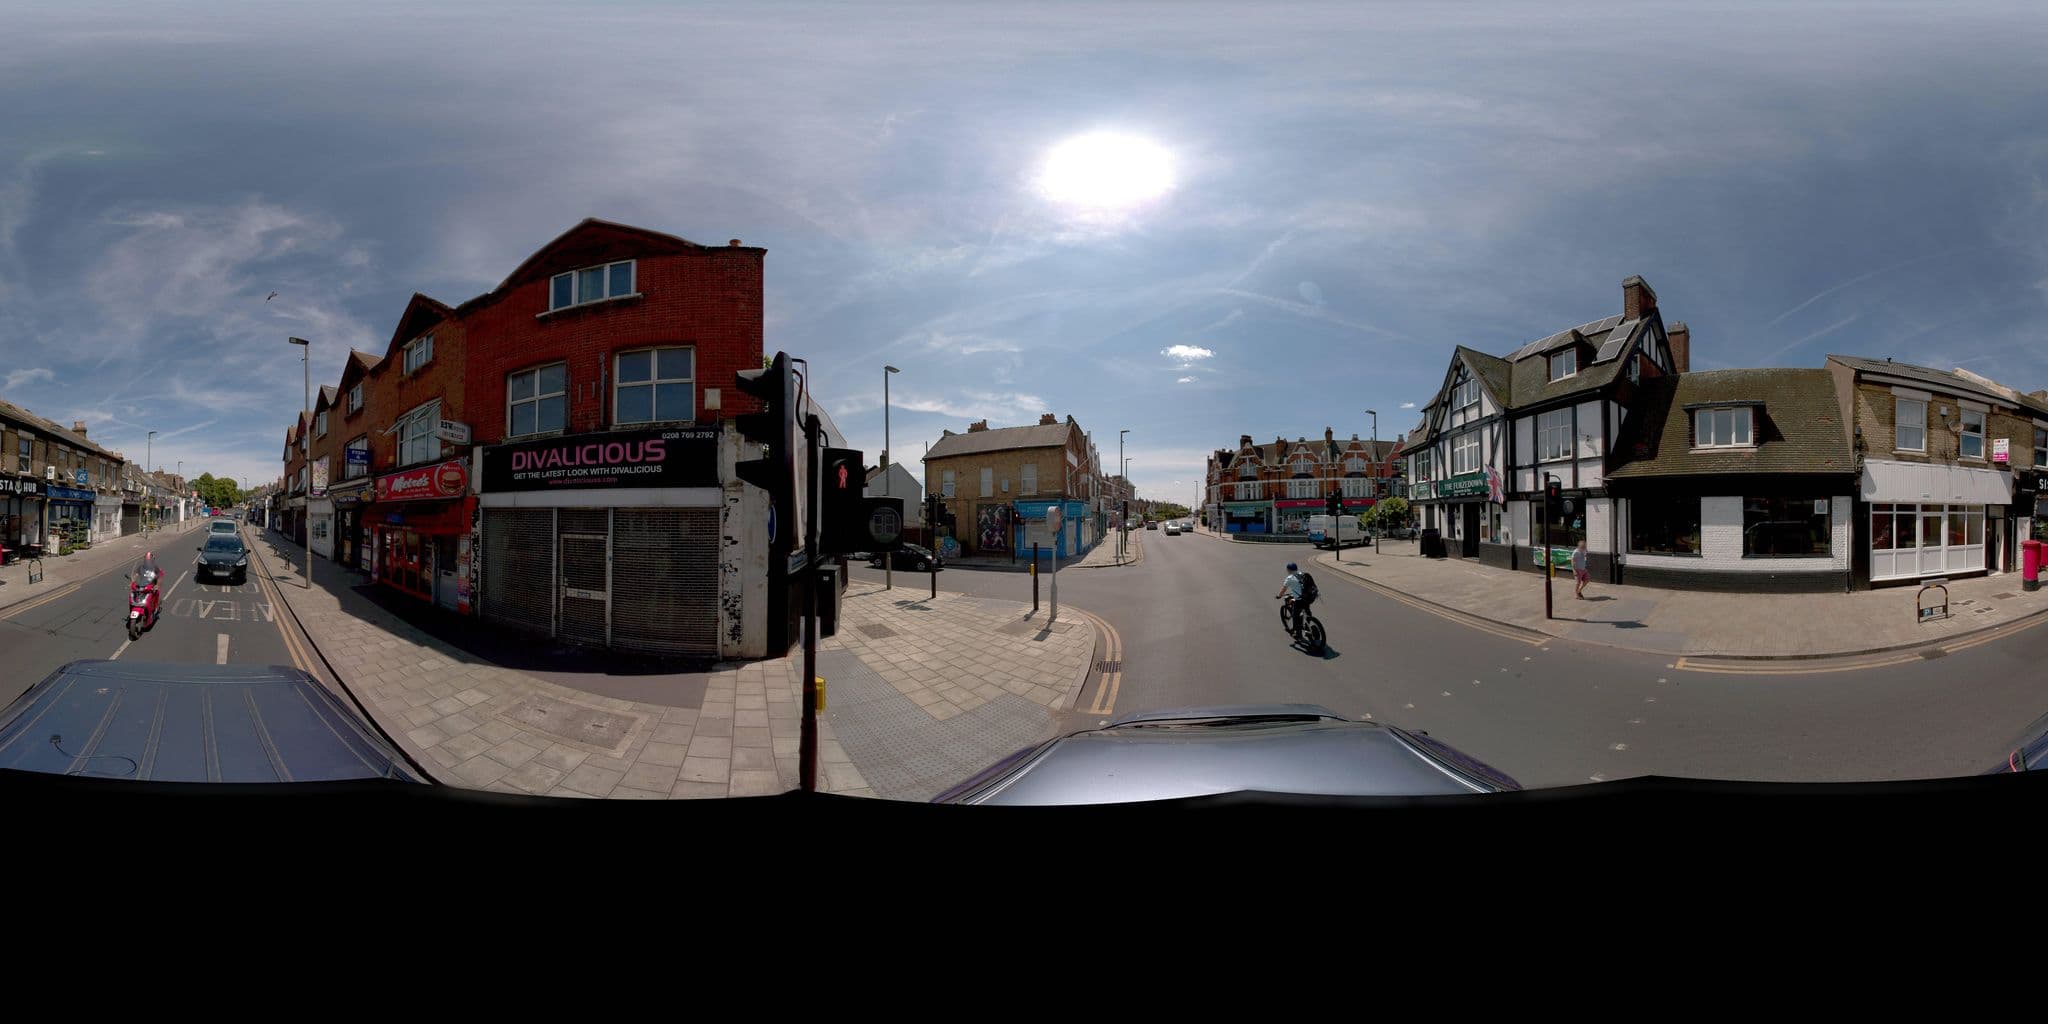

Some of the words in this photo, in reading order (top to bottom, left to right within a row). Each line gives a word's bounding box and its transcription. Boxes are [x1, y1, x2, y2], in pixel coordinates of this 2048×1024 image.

[662, 432, 679, 440] 0208
[696, 431, 714, 439] 2792
[511, 439, 666, 471] DIVALICIOUS
[514, 472, 526, 480] GET
[528, 471, 540, 479] THE
[541, 469, 566, 478] LATEST
[567, 468, 588, 476] LOOK
[589, 467, 610, 475] WITH
[611, 465, 663, 474] DIVALICIOUS
[23, 481, 37, 493] HUB
[1444, 483, 1453, 491] THE
[1453, 479, 1484, 490] FURZEDOWN
